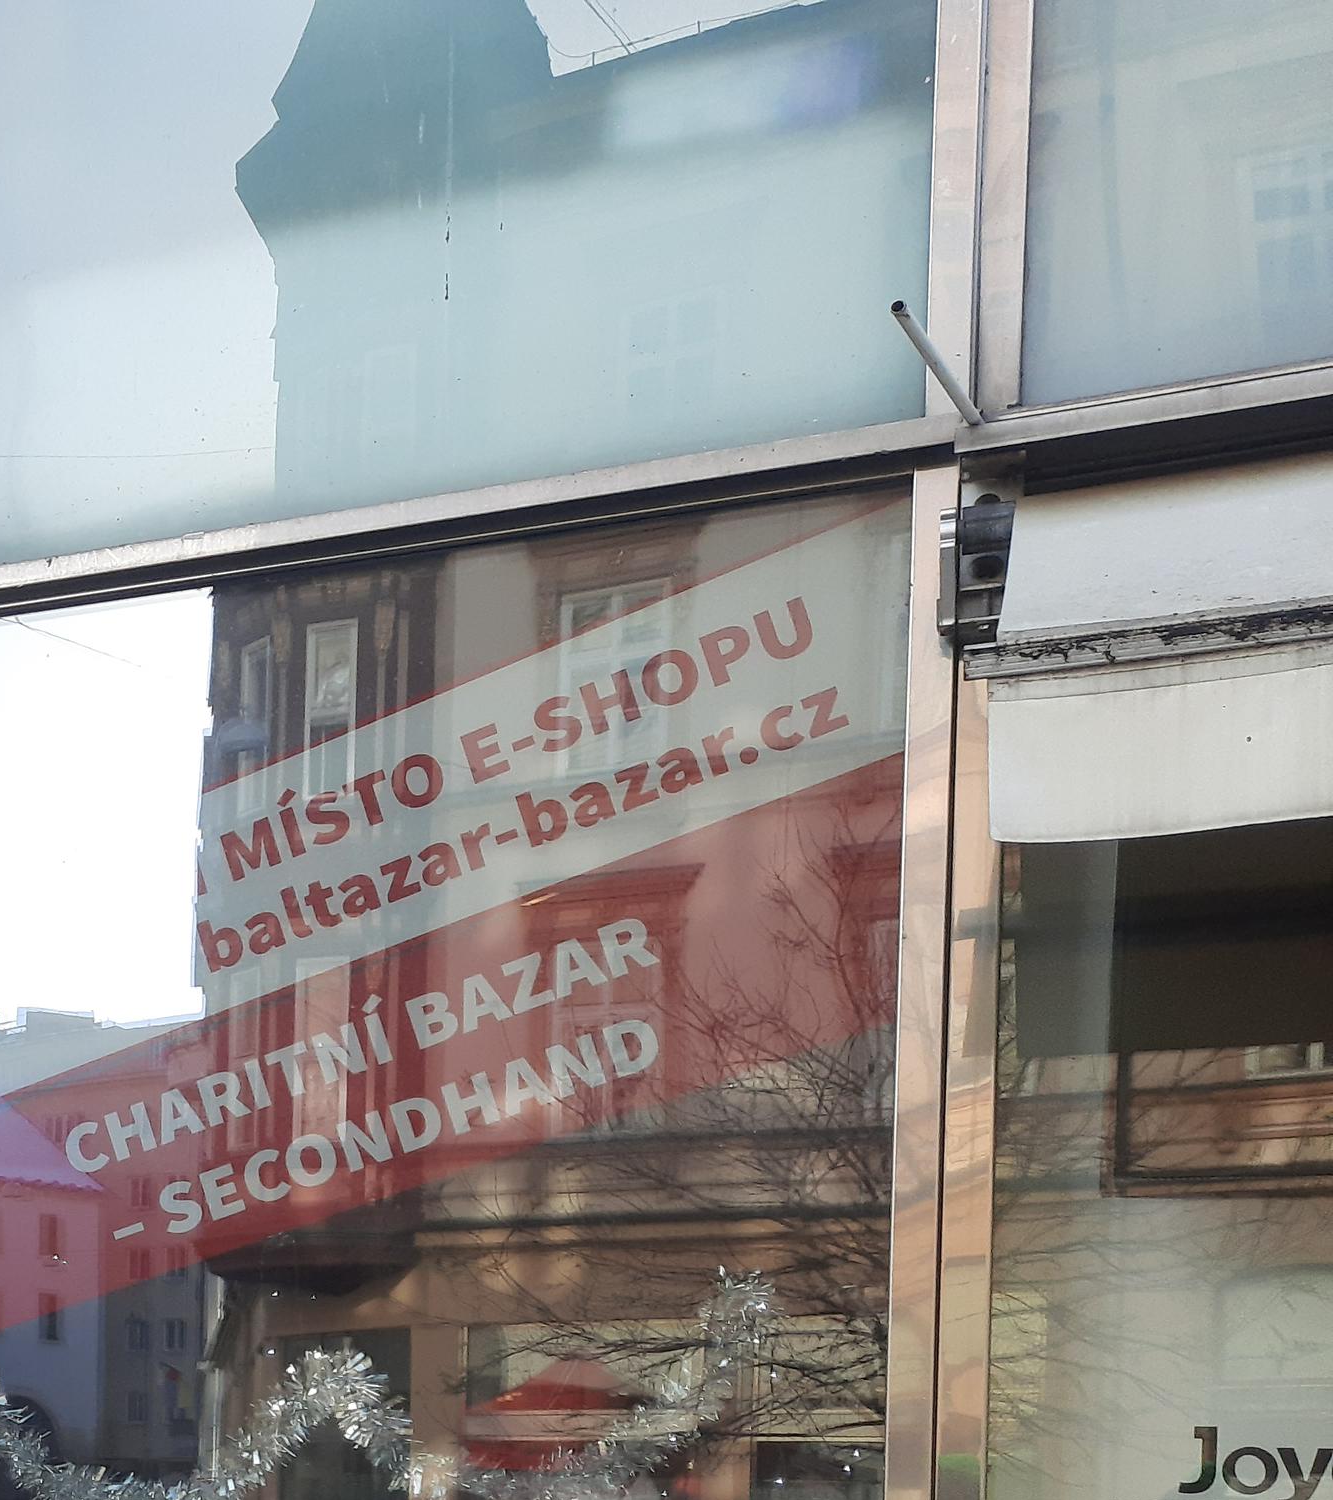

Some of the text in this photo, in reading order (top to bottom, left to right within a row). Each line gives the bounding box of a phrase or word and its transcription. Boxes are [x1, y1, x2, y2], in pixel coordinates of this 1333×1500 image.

[197, 685, 851, 974] baltazar-bazar.cz
[219, 596, 815, 883] MÍSTO E-SHOPU
[65, 915, 662, 1176] CHARITNÍ BAZAR
[157, 1016, 661, 1236] SECONDHAND
